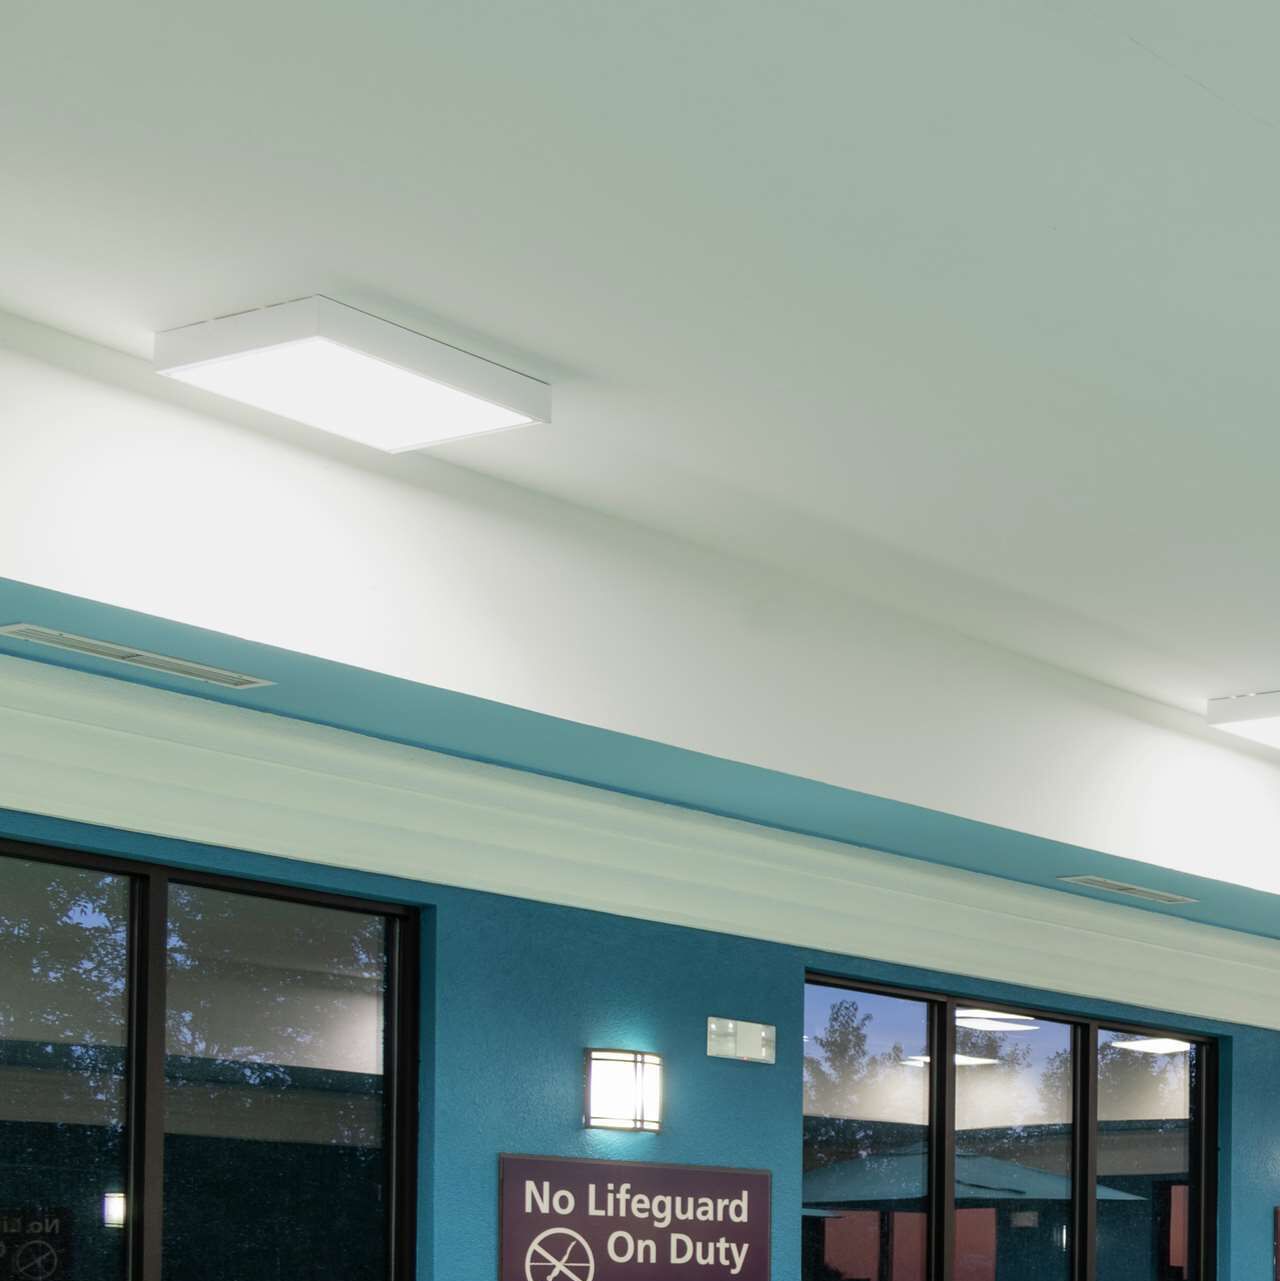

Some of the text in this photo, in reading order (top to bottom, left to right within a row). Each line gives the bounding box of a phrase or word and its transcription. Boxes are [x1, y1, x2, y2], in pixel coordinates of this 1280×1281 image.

[525, 1180, 748, 1228] No Lifeguard
[607, 1230, 749, 1275] On Duty
